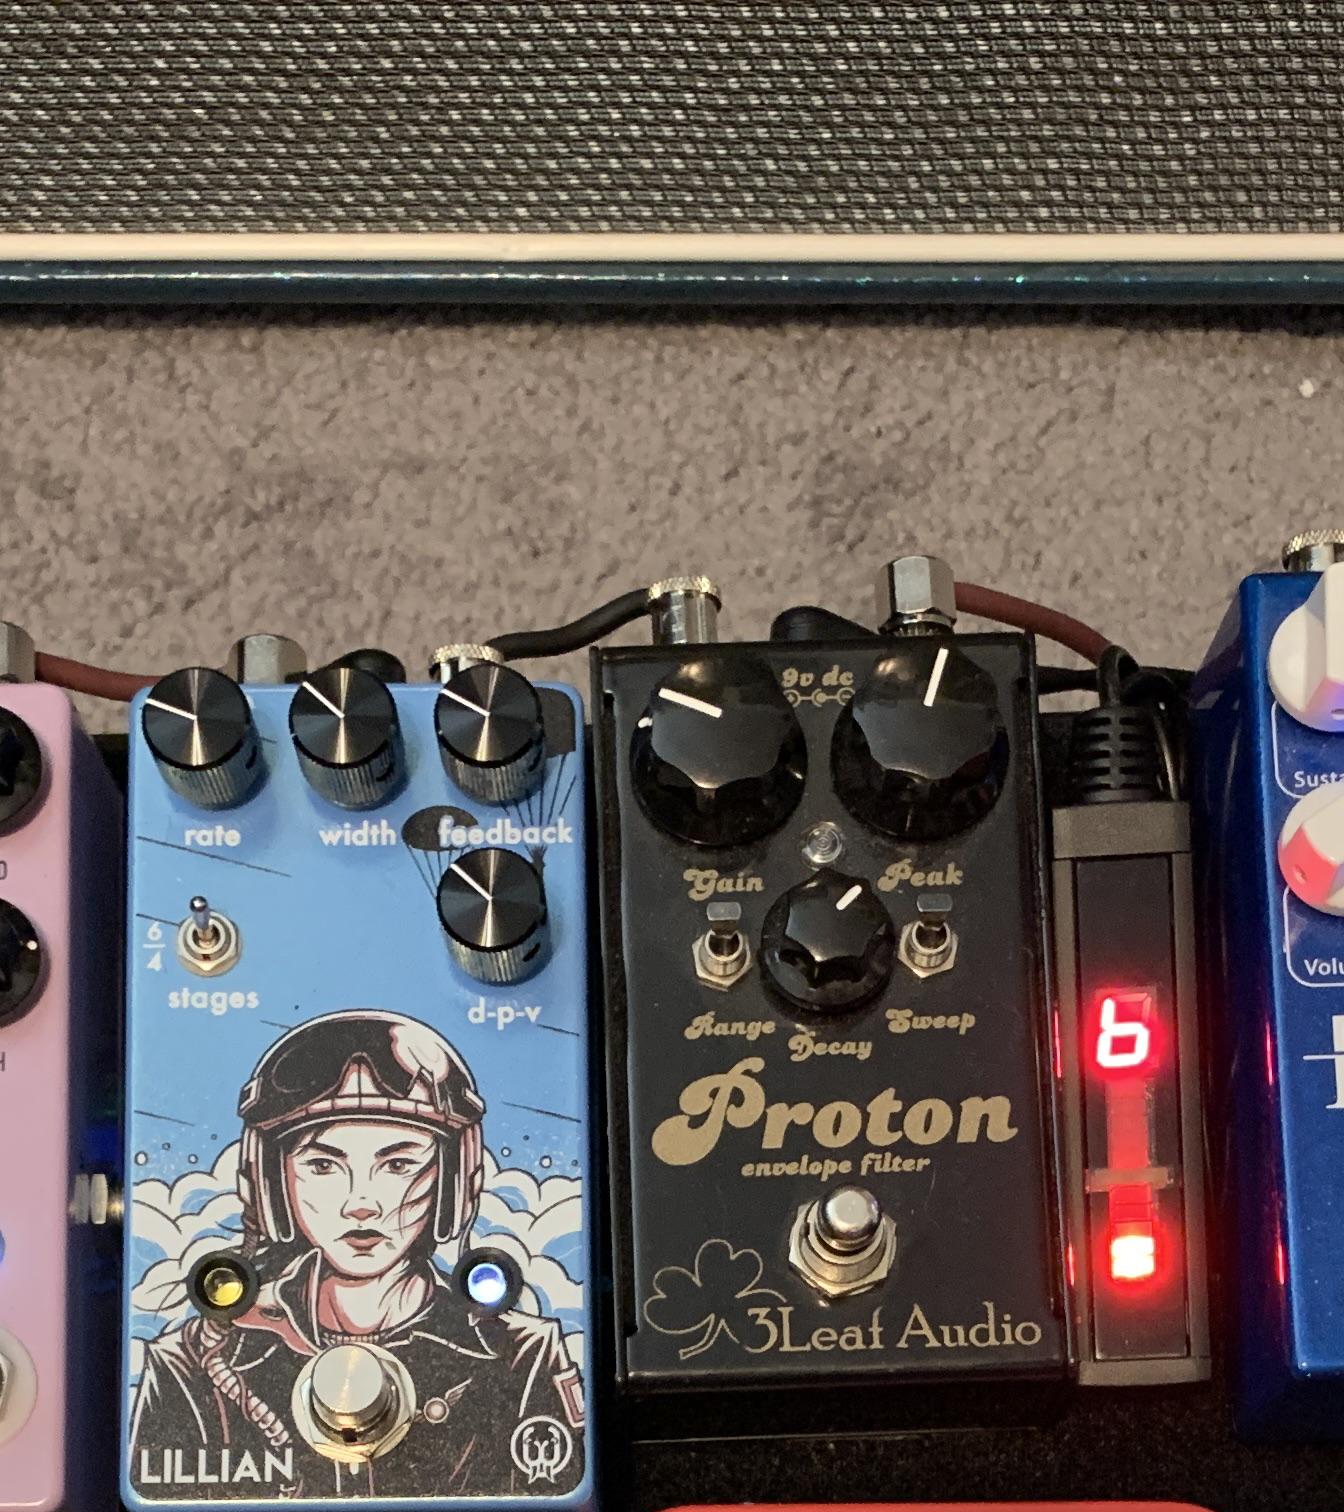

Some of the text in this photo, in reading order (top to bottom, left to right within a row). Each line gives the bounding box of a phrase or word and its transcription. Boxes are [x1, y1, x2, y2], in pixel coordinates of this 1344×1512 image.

[184, 815, 573, 846] rate width feedback
[683, 867, 764, 901] Gain
[877, 859, 964, 893] Peak
[168, 987, 259, 1015] stages
[468, 998, 542, 1029] d-p-v
[684, 1011, 776, 1040] Range
[885, 1007, 976, 1036] Sweep
[788, 1028, 873, 1062] Decay
[652, 1056, 1019, 1166] Proton
[741, 1151, 931, 1181] envelope filter
[747, 1303, 1042, 1354] 3Leaf Audio
[141, 1448, 293, 1484] LILLIAN
